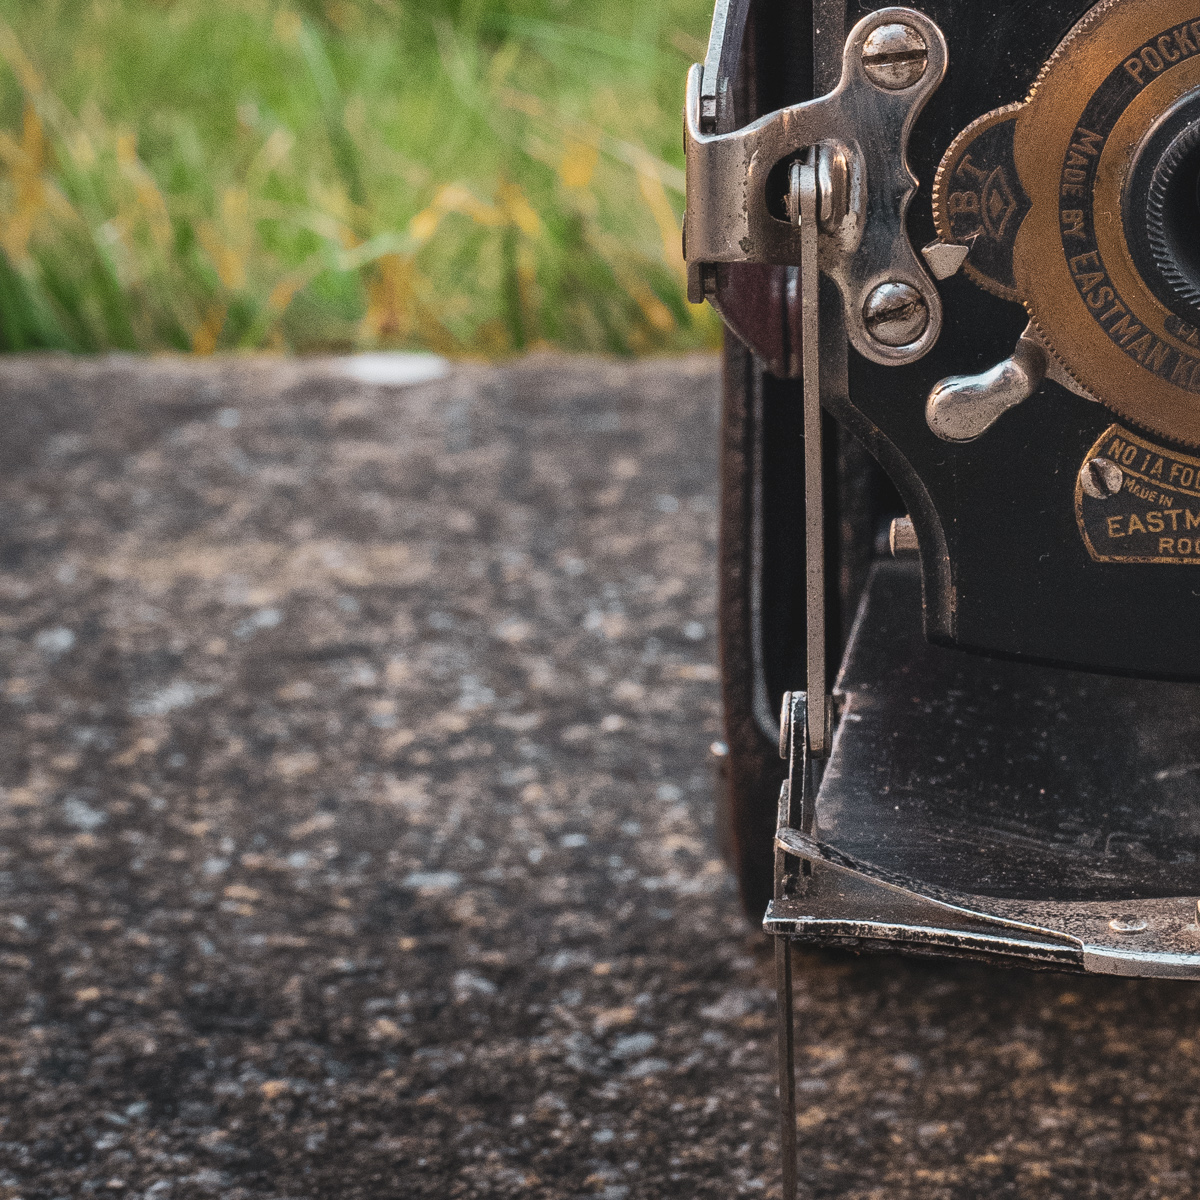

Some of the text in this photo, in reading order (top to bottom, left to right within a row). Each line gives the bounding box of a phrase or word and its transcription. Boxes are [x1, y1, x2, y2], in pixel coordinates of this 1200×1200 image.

[956, 153, 988, 183] T
[1062, 126, 1104, 197] MADE
[949, 190, 980, 214] B
[1061, 209, 1087, 239] BY
[1069, 249, 1171, 372] EASTMAN
[1140, 453, 1164, 480] 1A
[1122, 477, 1174, 508] MADE IN
